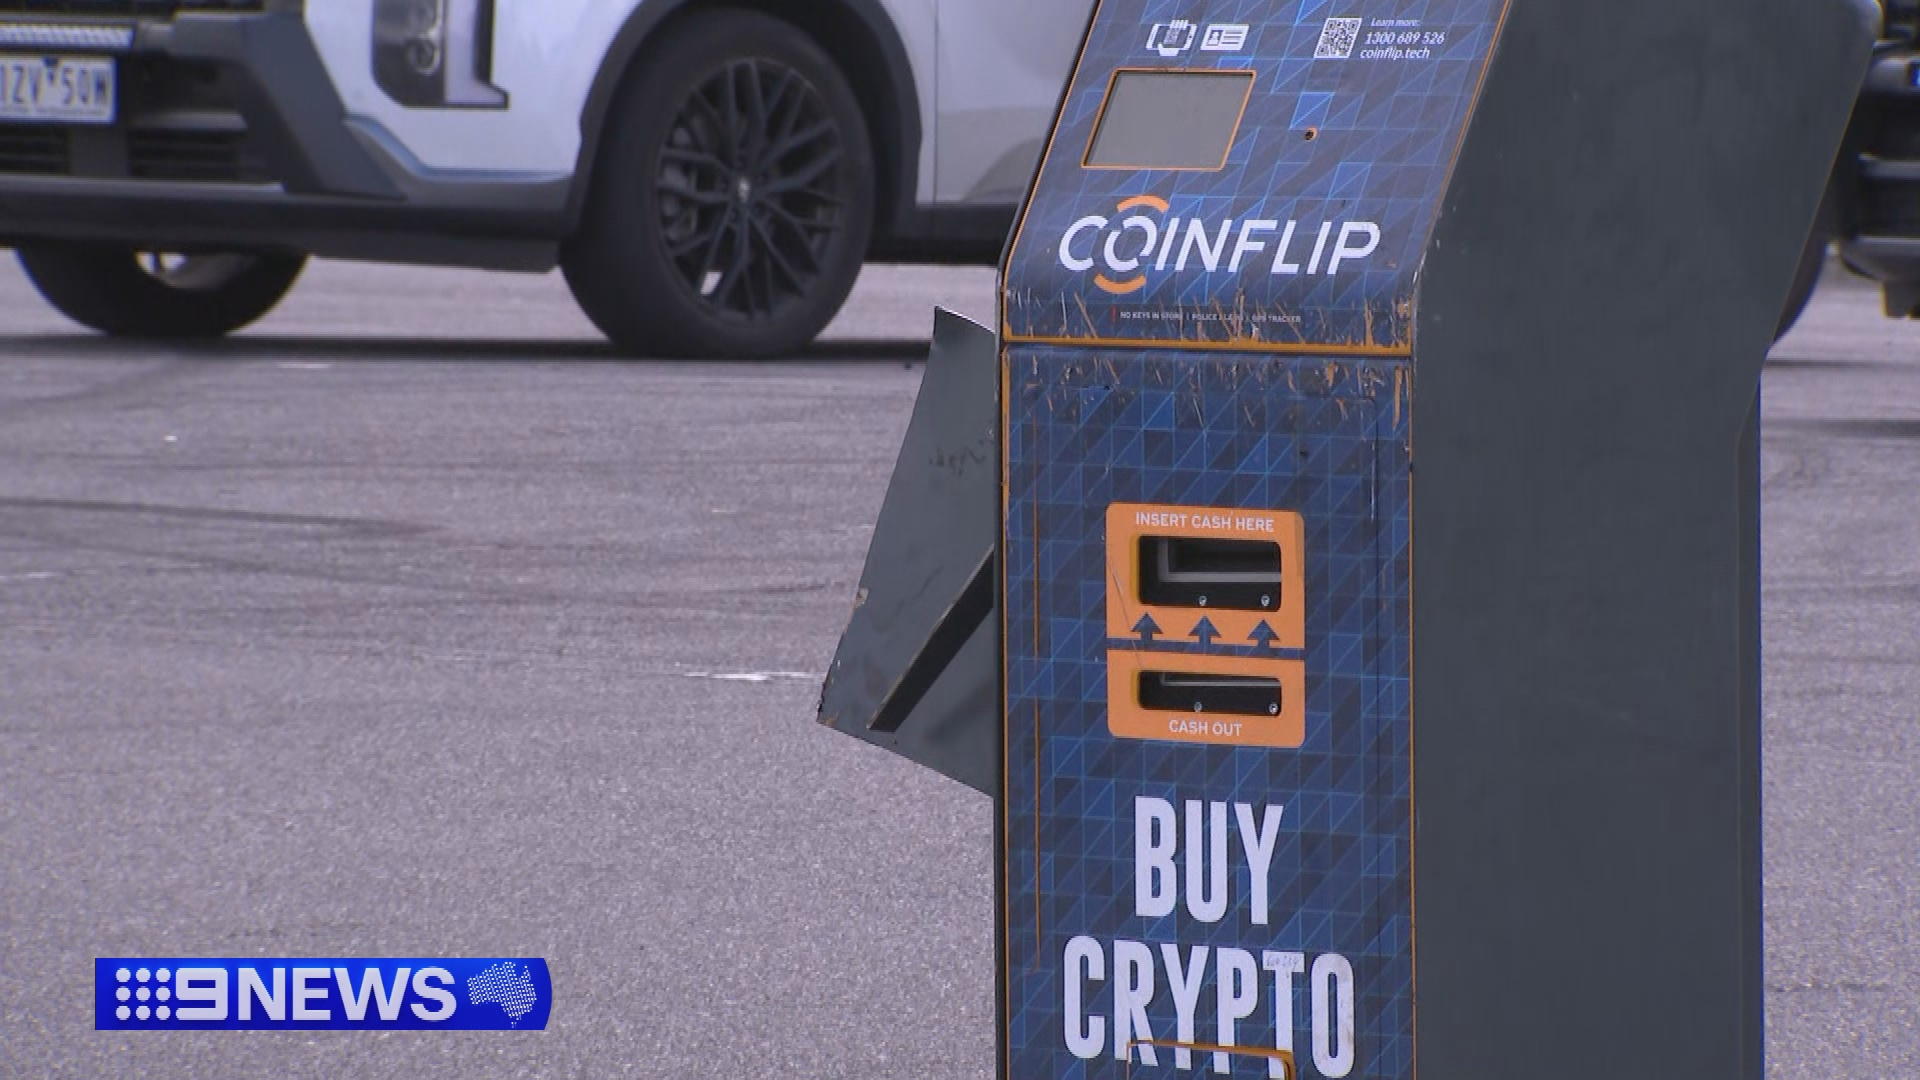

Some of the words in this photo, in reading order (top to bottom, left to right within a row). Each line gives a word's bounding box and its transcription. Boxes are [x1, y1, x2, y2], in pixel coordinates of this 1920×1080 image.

[1370, 18, 1395, 27] Learn
[1395, 19, 1421, 27] more:
[1364, 31, 1396, 45] 1300
[1396, 31, 1421, 45] 689
[1422, 31, 1446, 45] 526
[1359, 46, 1431, 61] coinflip.tech
[1058, 215, 1381, 275] COINFLIP
[1120, 311, 1132, 319] NO
[1132, 311, 1151, 319] KEYS
[1151, 311, 1160, 319] IN
[1135, 511, 1187, 528] INSERT
[1191, 514, 1232, 530] CASH
[1235, 517, 1275, 532] HERE
[1168, 719, 1208, 735] CASH
[1211, 722, 1242, 737] OUT
[1134, 795, 1284, 925] BUY
[1063, 935, 1354, 1079] CRYPTO
